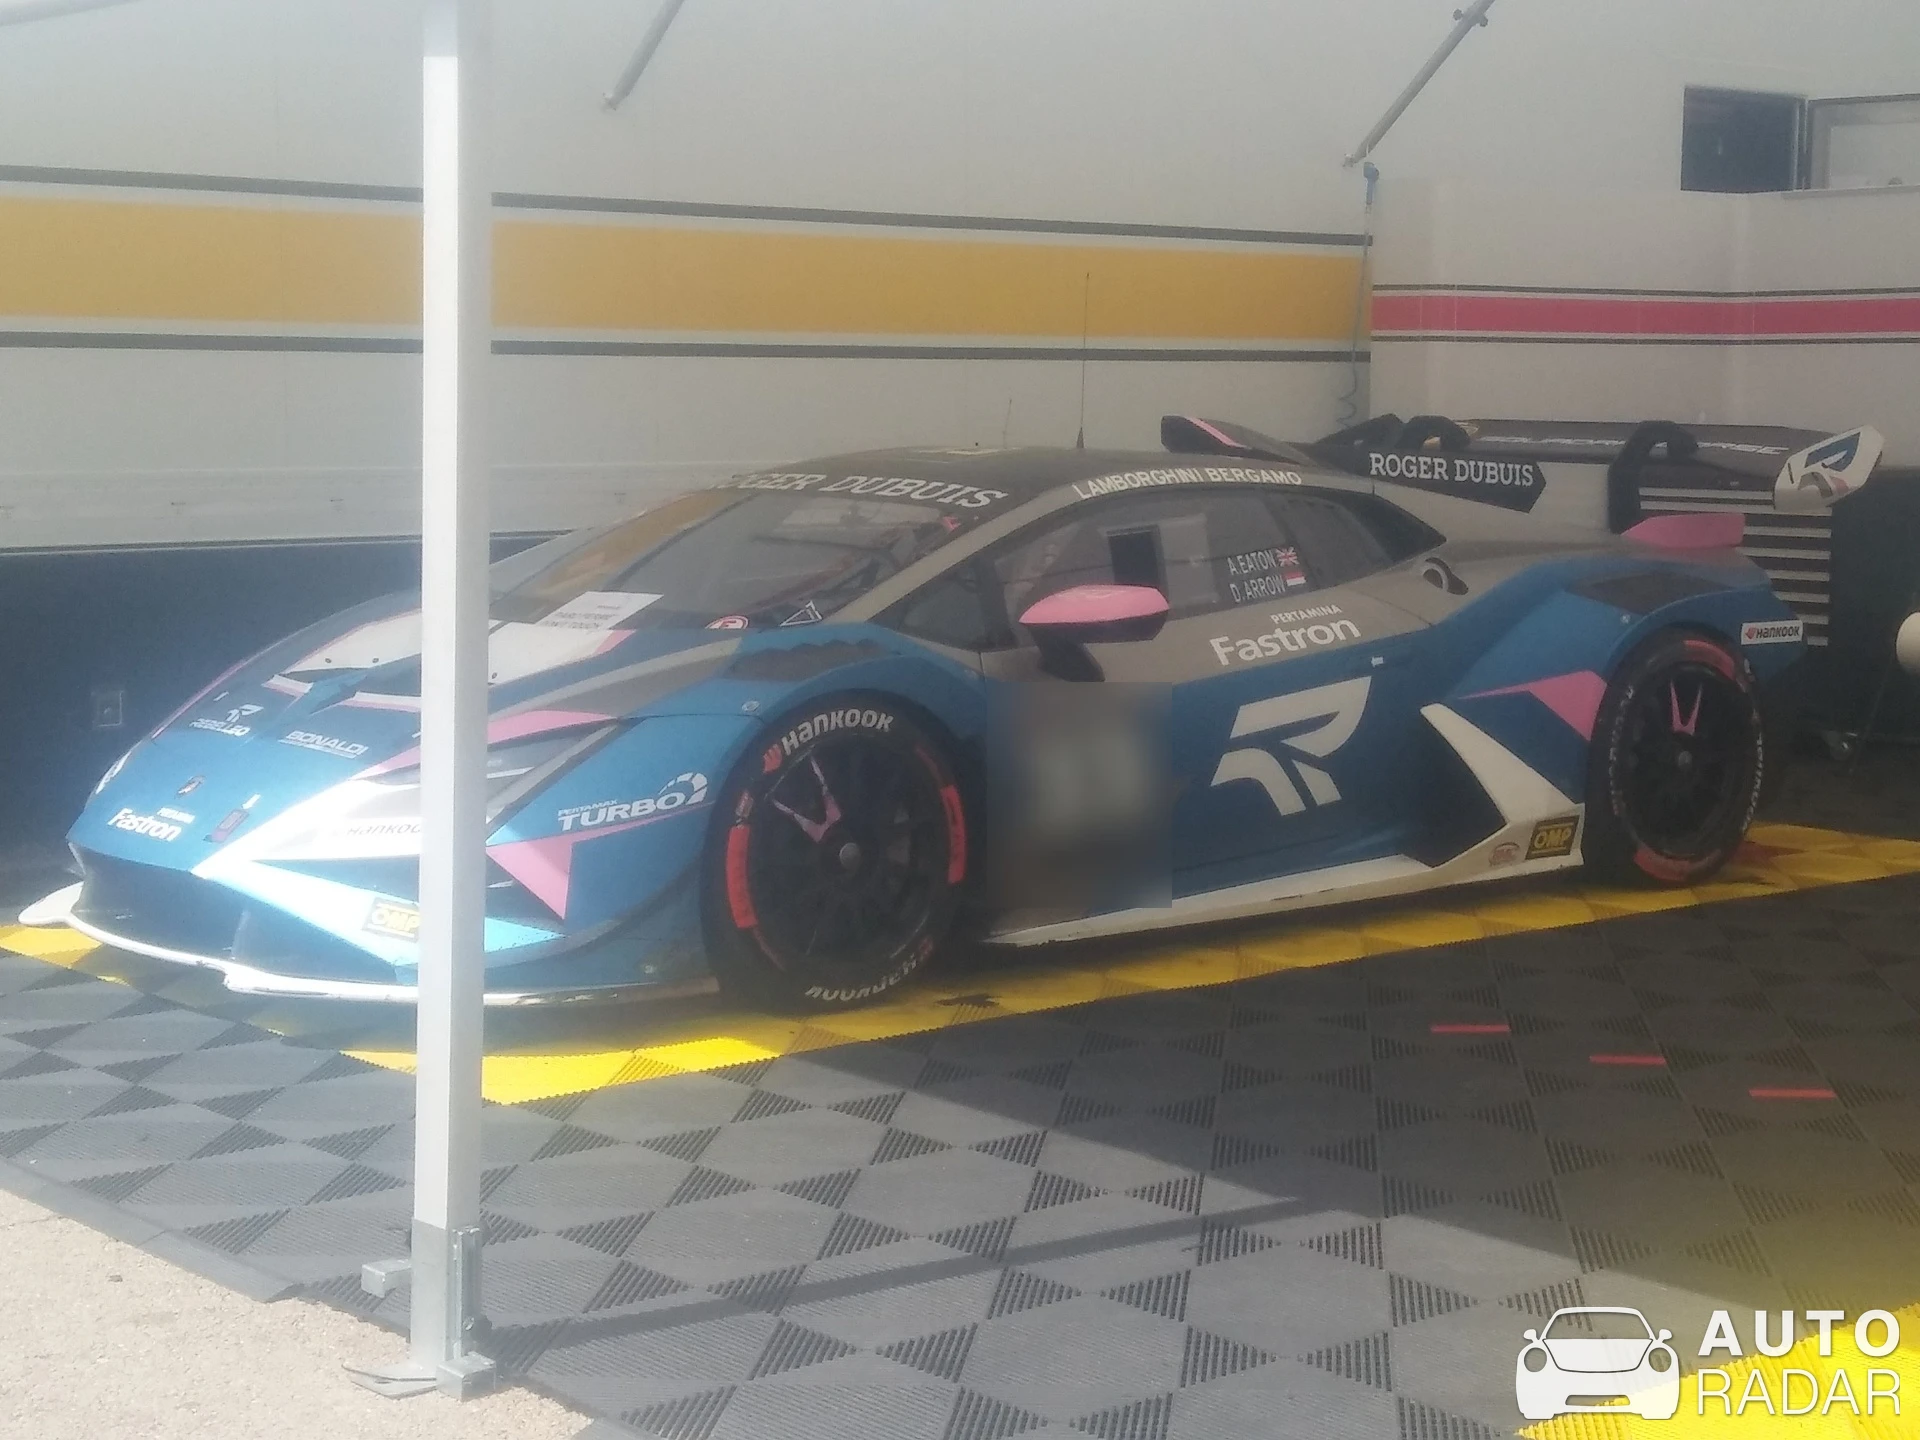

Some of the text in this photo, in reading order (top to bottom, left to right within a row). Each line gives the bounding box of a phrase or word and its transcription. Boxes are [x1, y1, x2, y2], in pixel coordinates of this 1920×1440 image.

[1073, 466, 1303, 499] LAMBORGHINI BERGAMO
[1368, 452, 1534, 487] ROGER DUBUIS
[818, 475, 1009, 508] DUBUIS
[1270, 604, 1343, 625] PERTAMINA
[1209, 618, 1361, 666] Fastron
[285, 730, 370, 756] BONALDI
[107, 807, 183, 842] Fastron
[557, 792, 686, 832] TURBO
[1533, 826, 1573, 850] OMP
